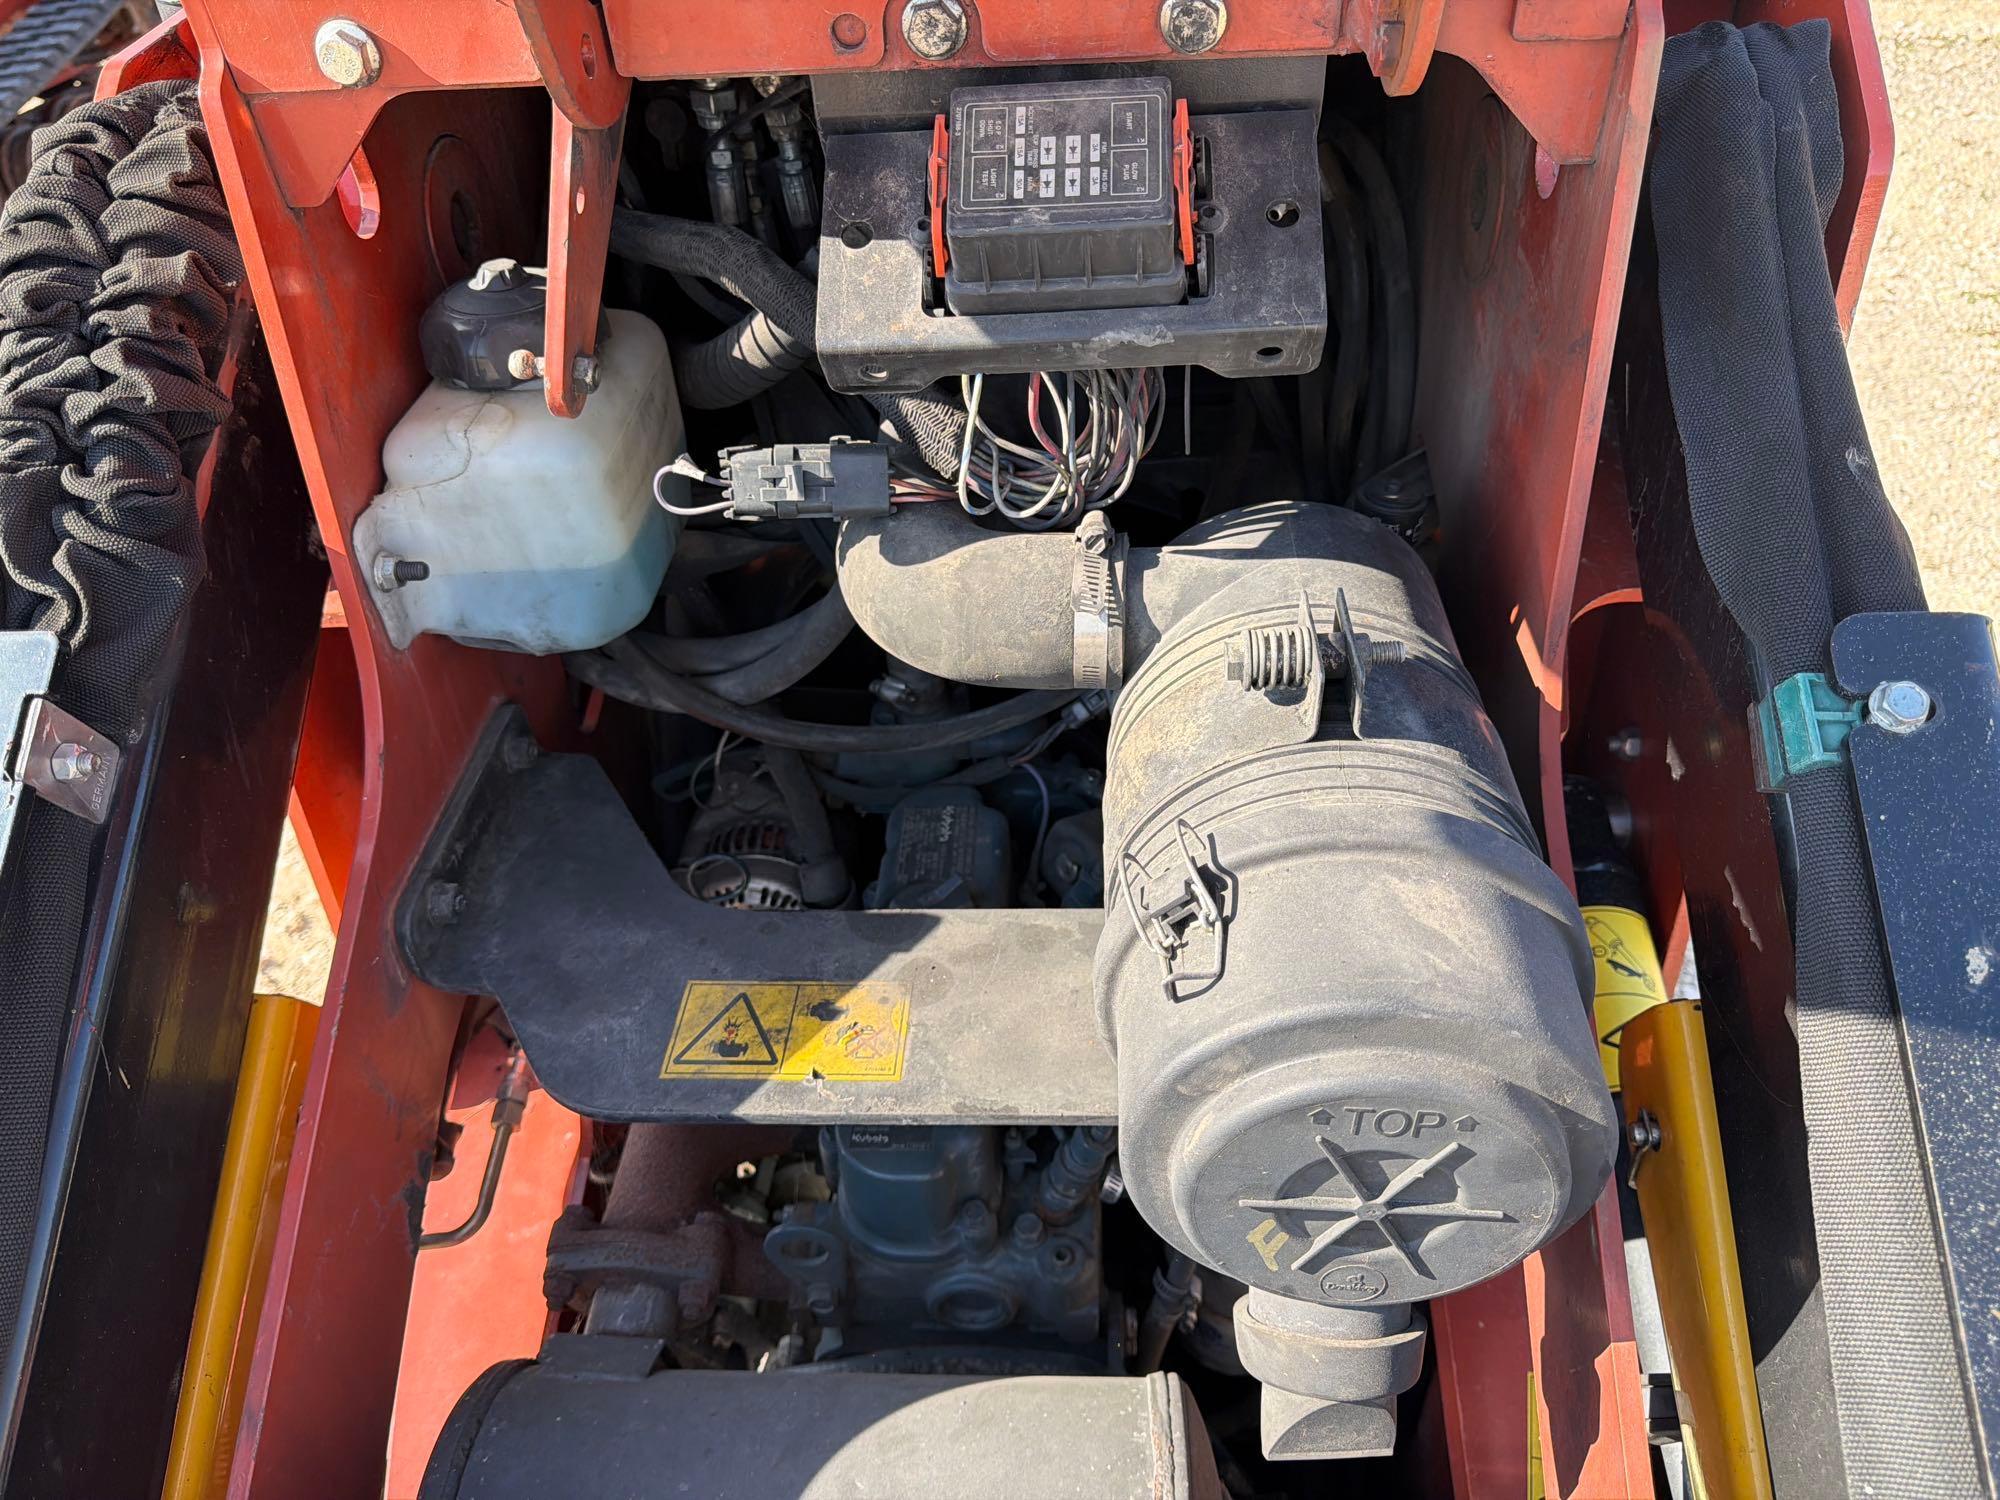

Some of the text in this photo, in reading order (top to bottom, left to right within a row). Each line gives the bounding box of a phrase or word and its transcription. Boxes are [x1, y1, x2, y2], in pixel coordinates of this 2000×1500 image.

[1092, 143, 1099, 152] 3A
[1015, 176, 1023, 191] 30A
[1092, 176, 1099, 186] 3A
[1343, 1106, 1448, 1139] TOP
[852, 1133, 889, 1144] Kubota
